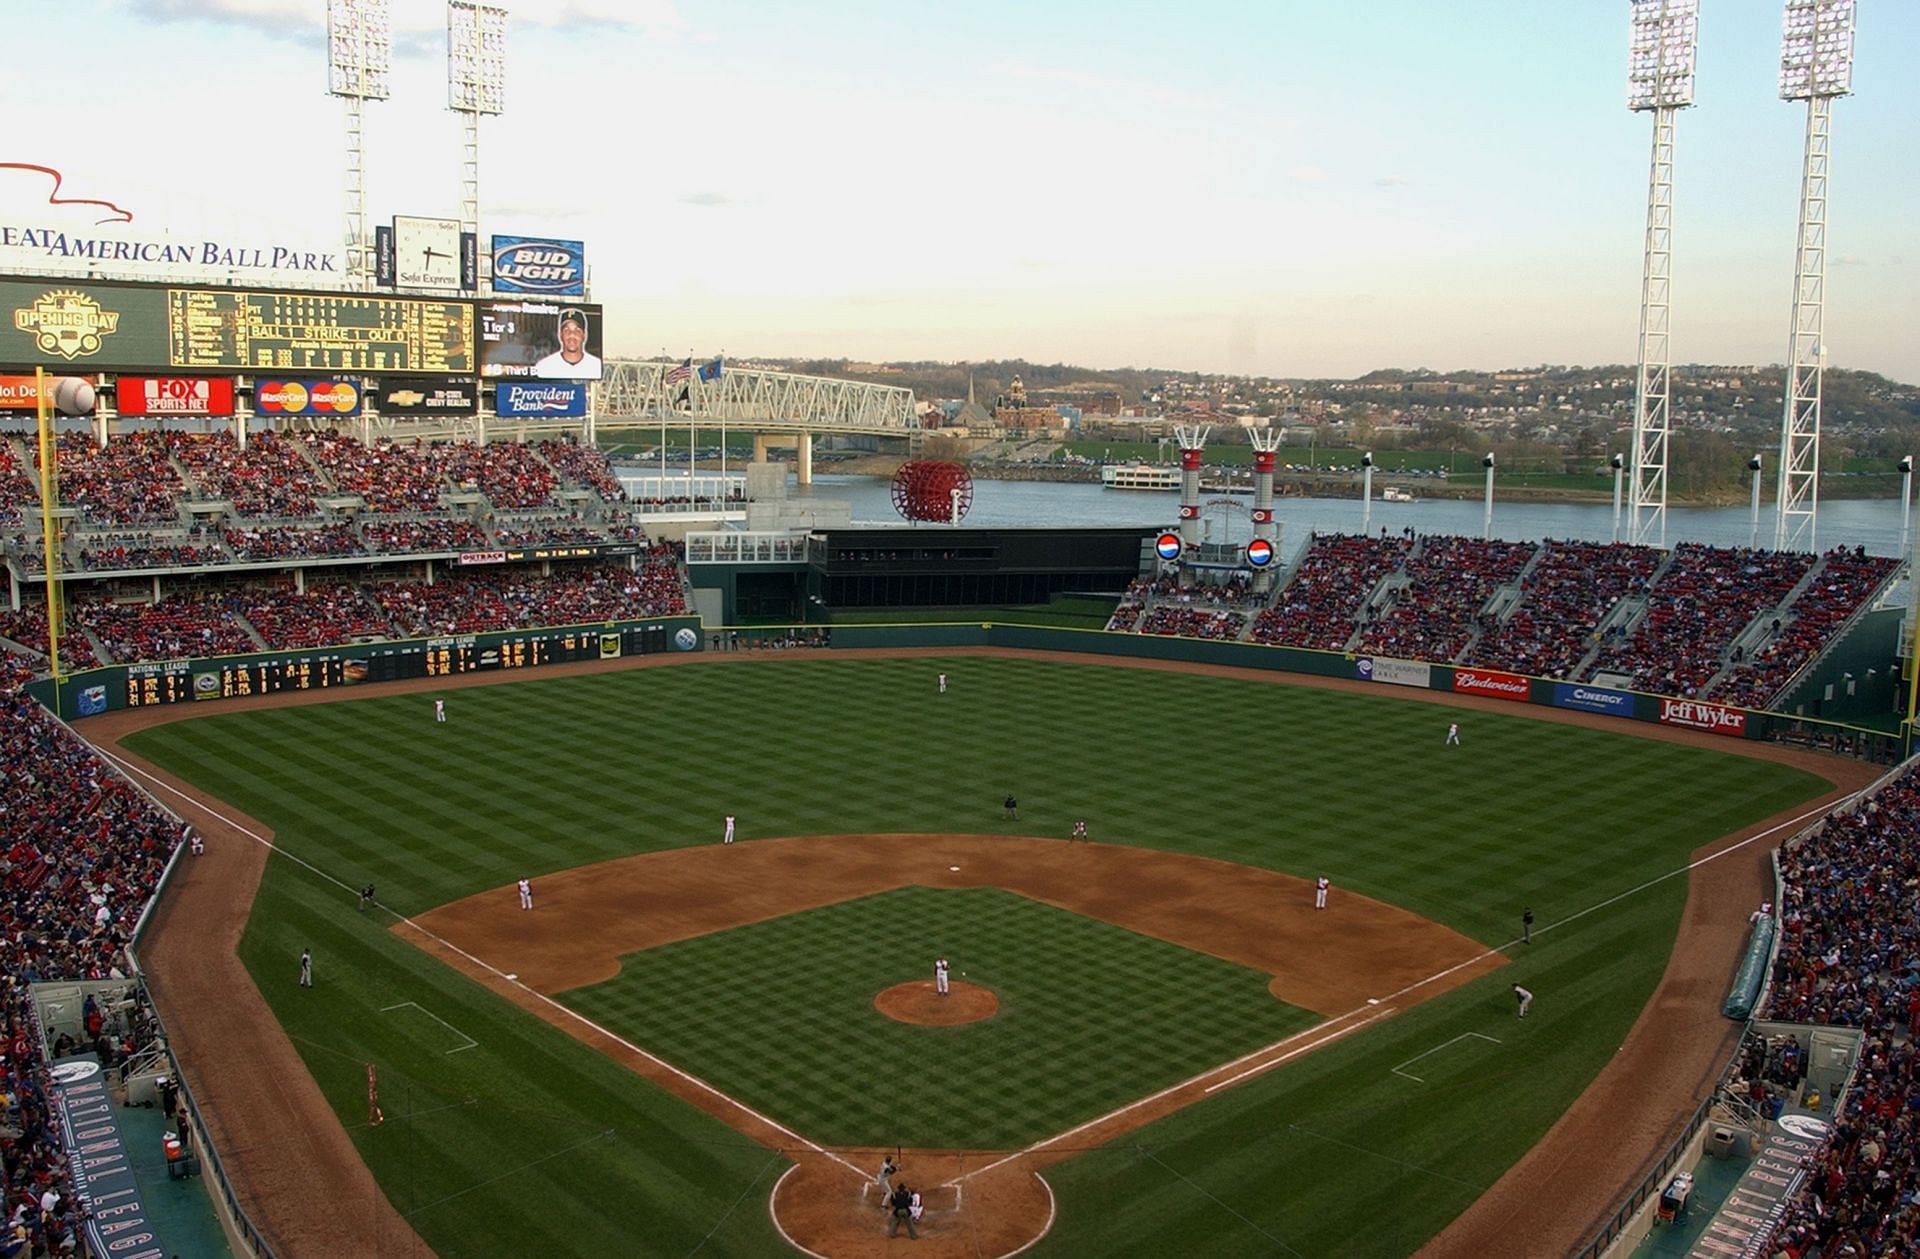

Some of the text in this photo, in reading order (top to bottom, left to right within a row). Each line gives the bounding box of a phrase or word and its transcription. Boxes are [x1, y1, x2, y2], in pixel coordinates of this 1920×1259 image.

[0, 226, 335, 272] EAT AMERICAN BALL PARK
[514, 250, 571, 267] BUD
[423, 273, 456, 286] Express
[500, 264, 577, 281] LIGHT
[18, 311, 116, 330] OPENING DAY
[252, 325, 405, 341] BALL 1 STRIKE 1 OUT 0
[20, 385, 54, 398] Dels
[158, 380, 201, 398] FOX
[508, 386, 576, 402] Provident
[146, 399, 208, 410] SPORTS NET
[512, 399, 545, 411] Bank
[128, 661, 191, 674] NATIONAL LEAGUE
[1455, 672, 1528, 693] Budweiser
[1573, 688, 1623, 704] CINERGY
[1660, 700, 1696, 720] Jeff
[1695, 704, 1744, 728] Wyler
[65, 1082, 127, 1182] NATIONAL
